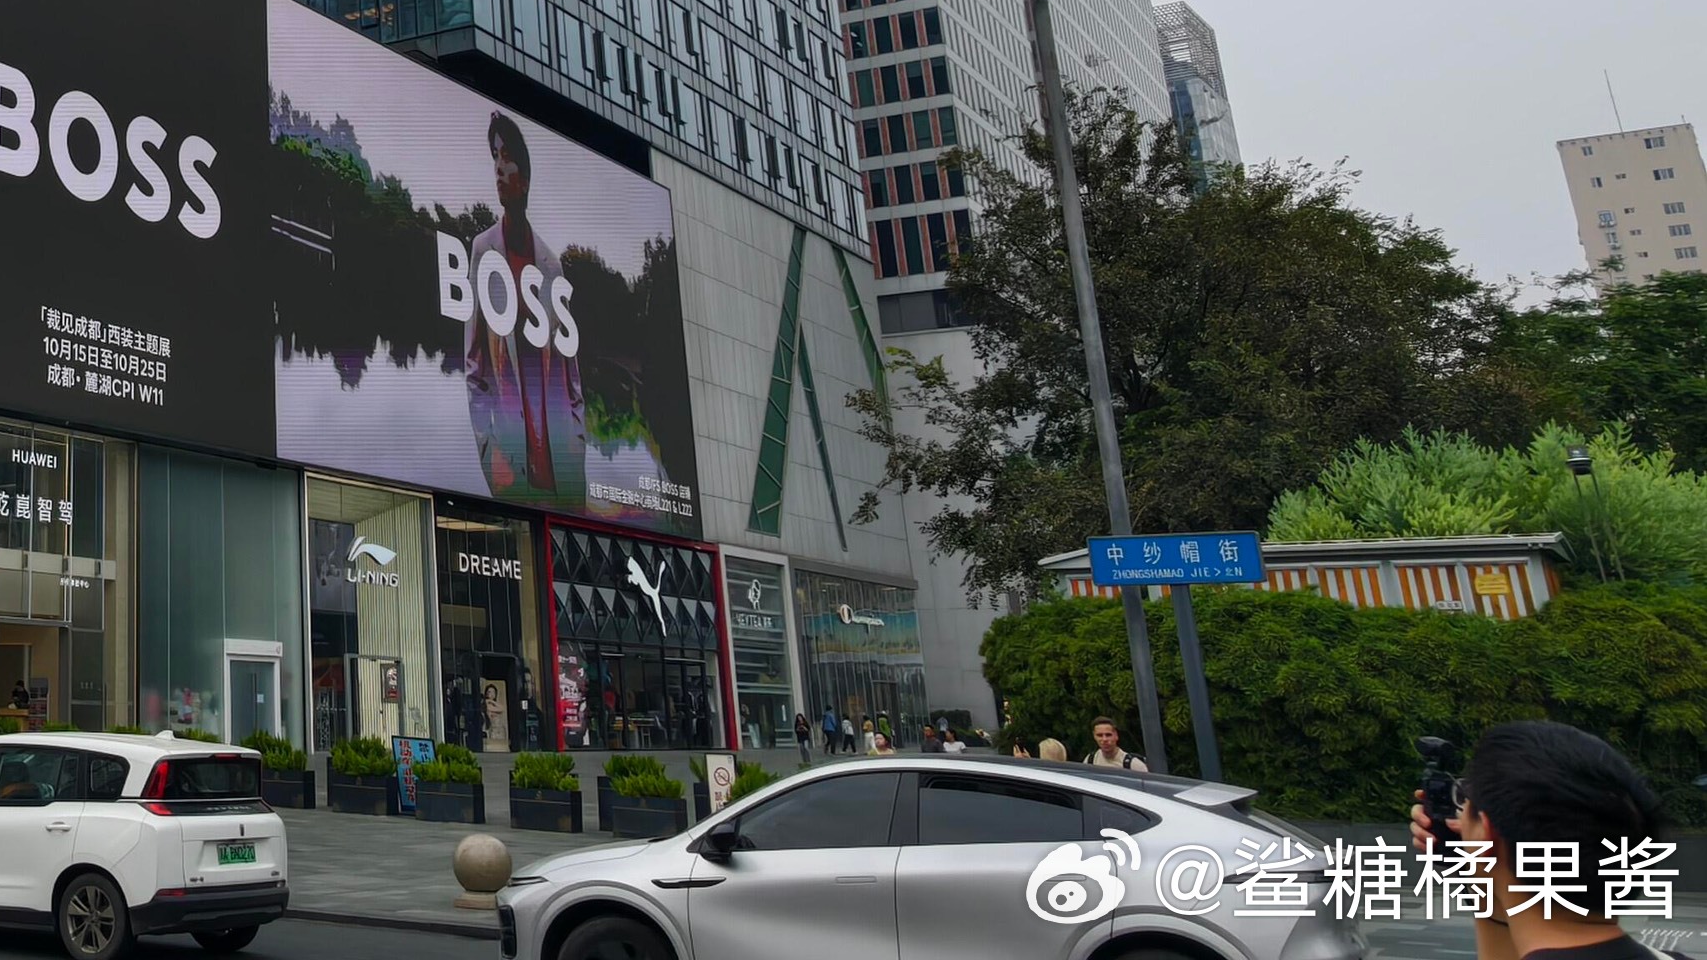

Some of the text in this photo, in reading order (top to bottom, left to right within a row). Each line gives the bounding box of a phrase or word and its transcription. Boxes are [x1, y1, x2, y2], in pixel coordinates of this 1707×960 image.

[437, 230, 579, 357] BOSS
[40, 305, 171, 358] 「裁见成都」西装主题展
[43, 336, 166, 382] 10月15日至10月25日
[138, 383, 164, 406] W11
[12, 448, 57, 469] HUAWEI
[1107, 539, 1238, 566] 中纱帽街
[347, 567, 399, 588] LI-NING
[458, 552, 523, 581] DREAME
[1112, 568, 1185, 580] ZHONGSHAMAO
[1190, 566, 1211, 578] JIE
